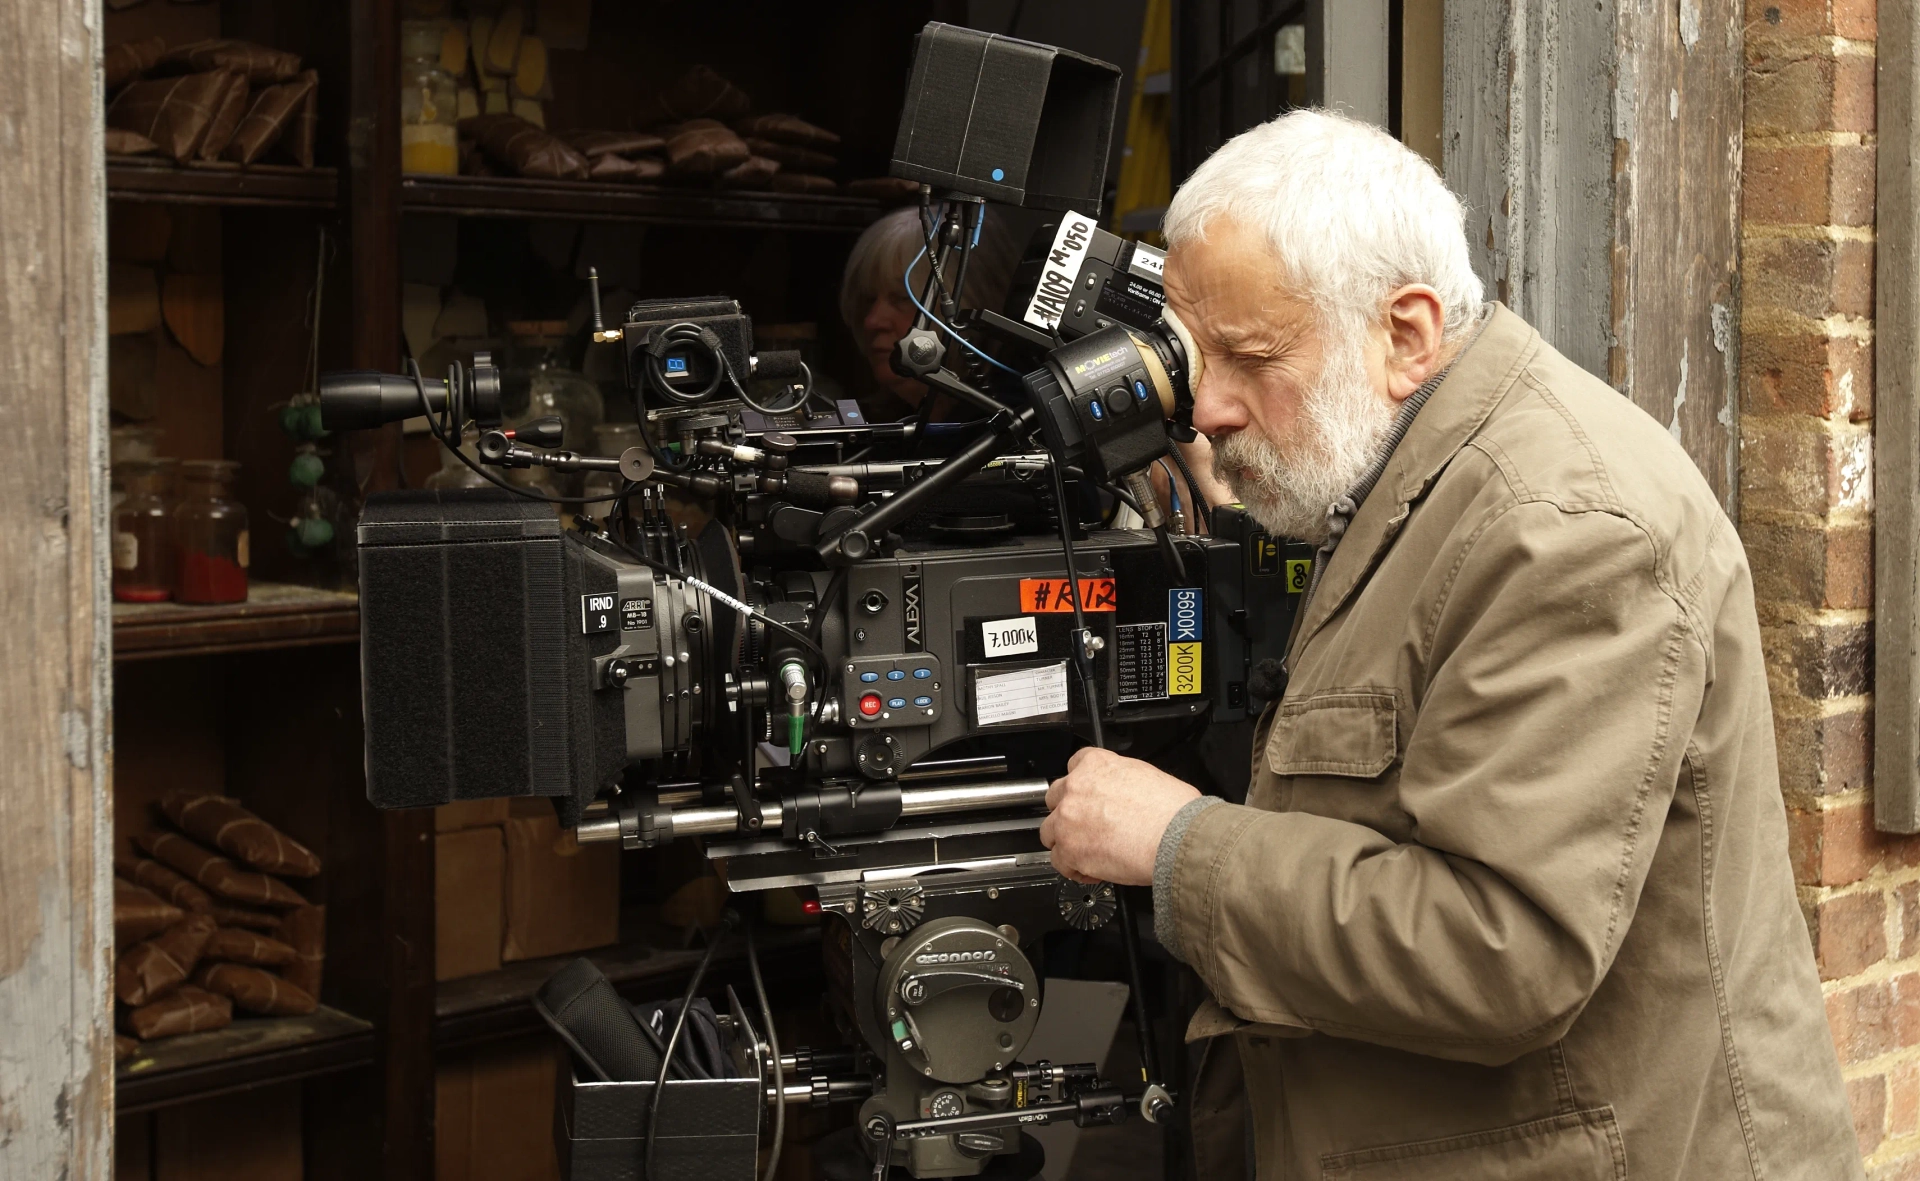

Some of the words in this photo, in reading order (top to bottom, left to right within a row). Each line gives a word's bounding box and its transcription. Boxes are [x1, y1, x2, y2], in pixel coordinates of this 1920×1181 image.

[590, 597, 613, 611] IRND
[1177, 591, 1195, 640] 5600K
[1176, 644, 1194, 692] 3200K
